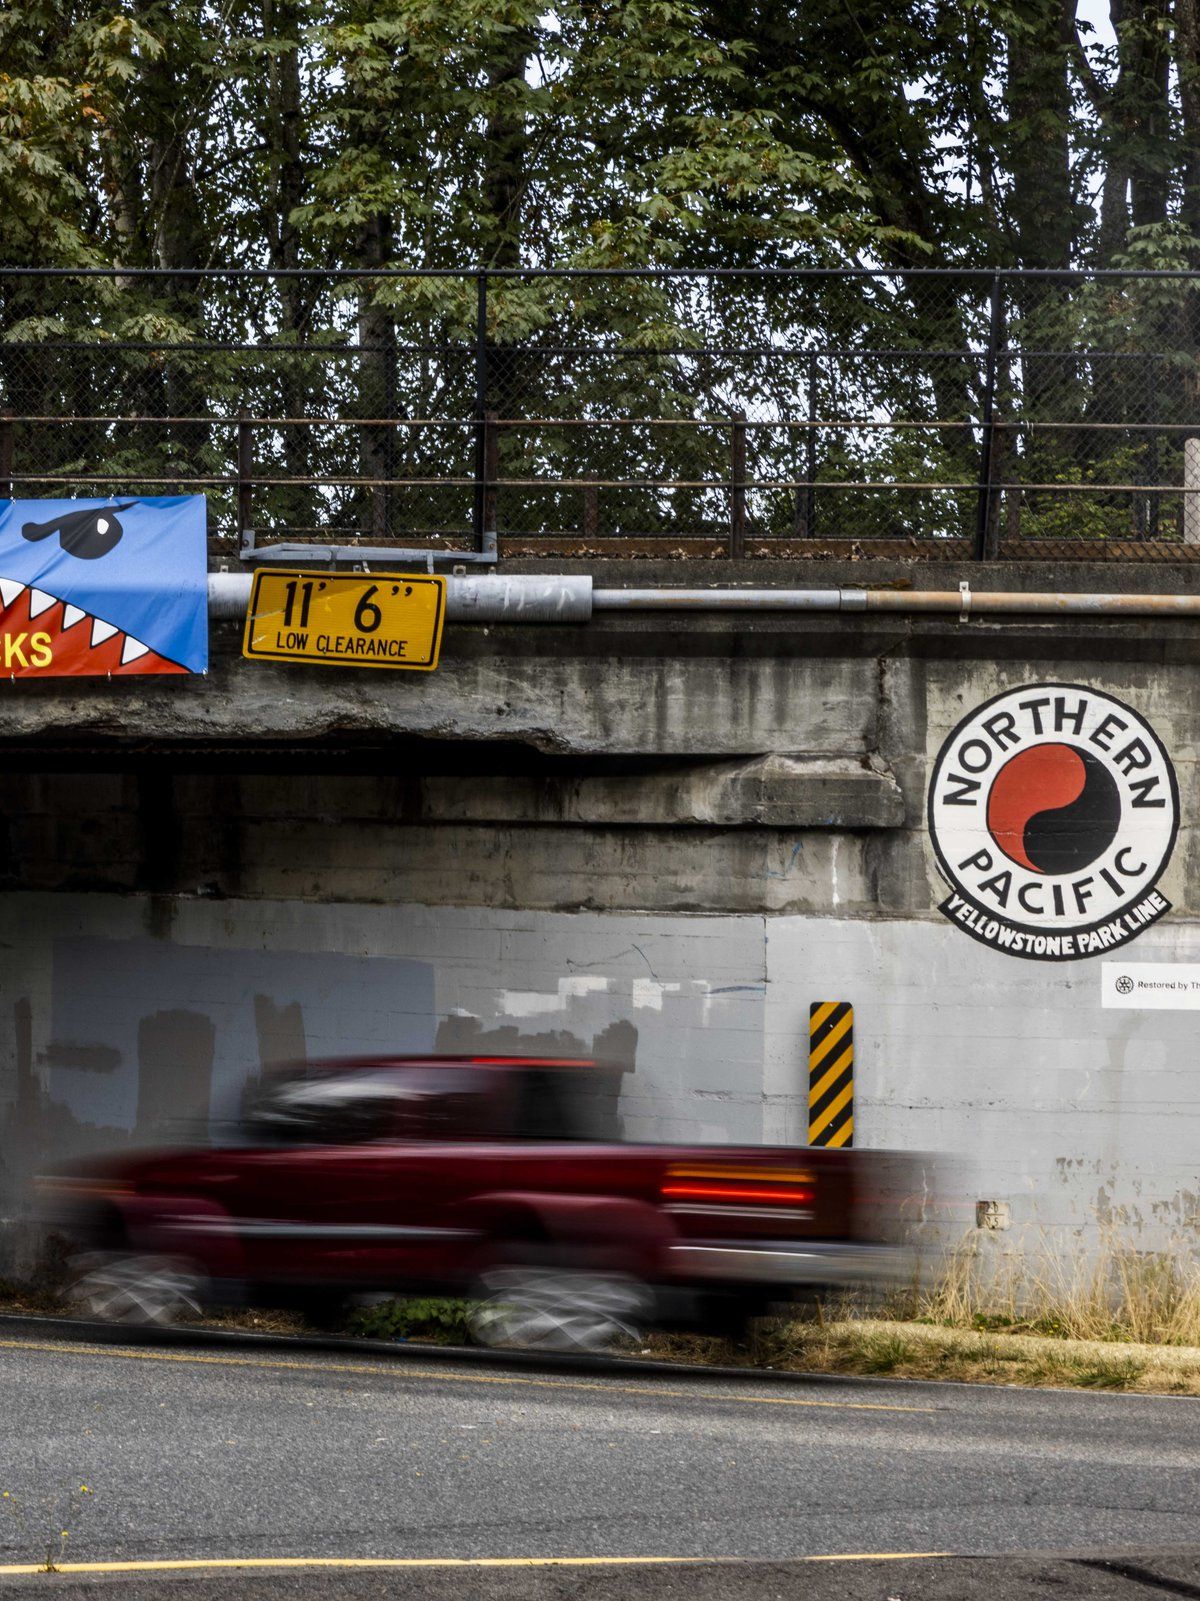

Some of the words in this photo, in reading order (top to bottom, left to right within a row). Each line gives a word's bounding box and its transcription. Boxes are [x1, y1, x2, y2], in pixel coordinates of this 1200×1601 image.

[276, 631, 309, 650] LOW
[316, 634, 408, 657] CLEARANCE
[942, 696, 1166, 809] NORTHERN
[957, 846, 1147, 917] PACIFIC
[947, 893, 1076, 956] YELLOWSTONE
[1077, 917, 1129, 953] PARK
[1124, 891, 1168, 931] LINE
[1137, 981, 1176, 989] Restored
[1178, 981, 1188, 991] by
